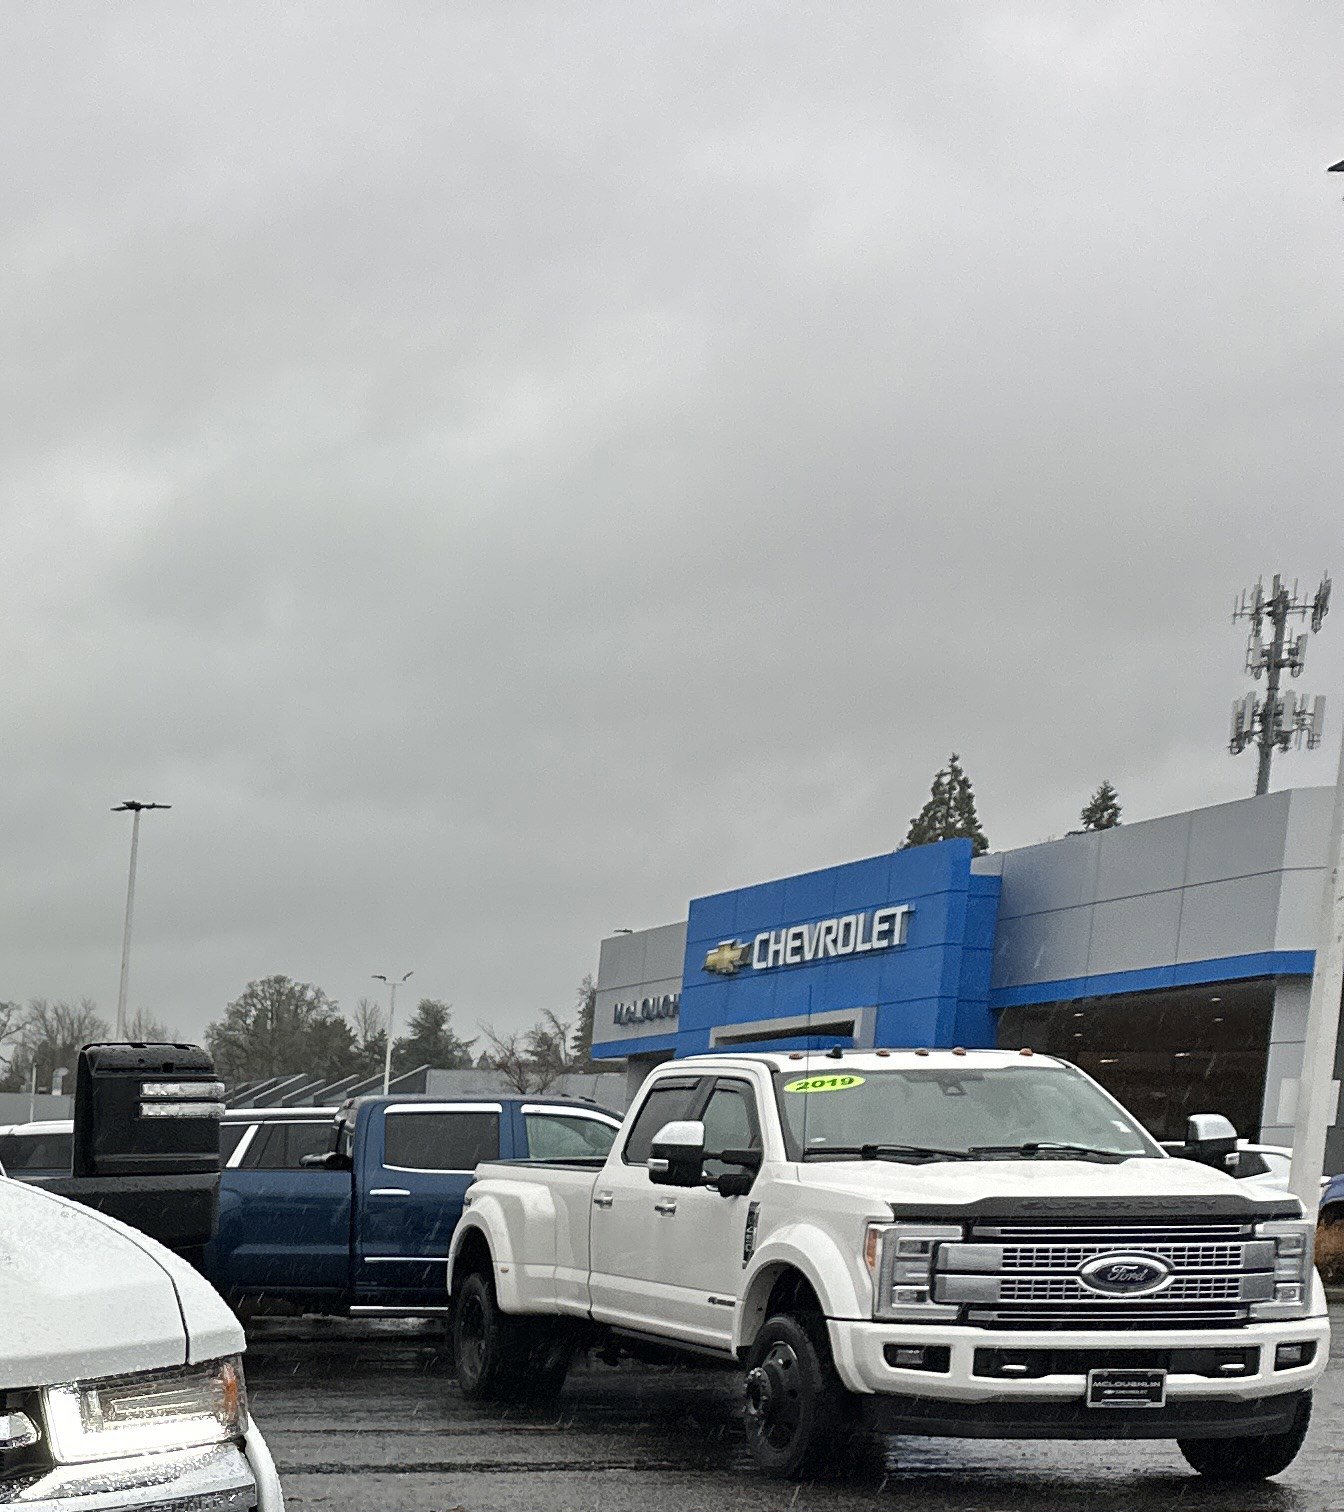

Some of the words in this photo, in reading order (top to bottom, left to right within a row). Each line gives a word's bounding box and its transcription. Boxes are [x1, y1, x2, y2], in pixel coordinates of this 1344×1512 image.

[752, 904, 910, 970] CHEVROLET
[795, 1076, 855, 1091] 2019
[1107, 1266, 1148, 1281] Ford
